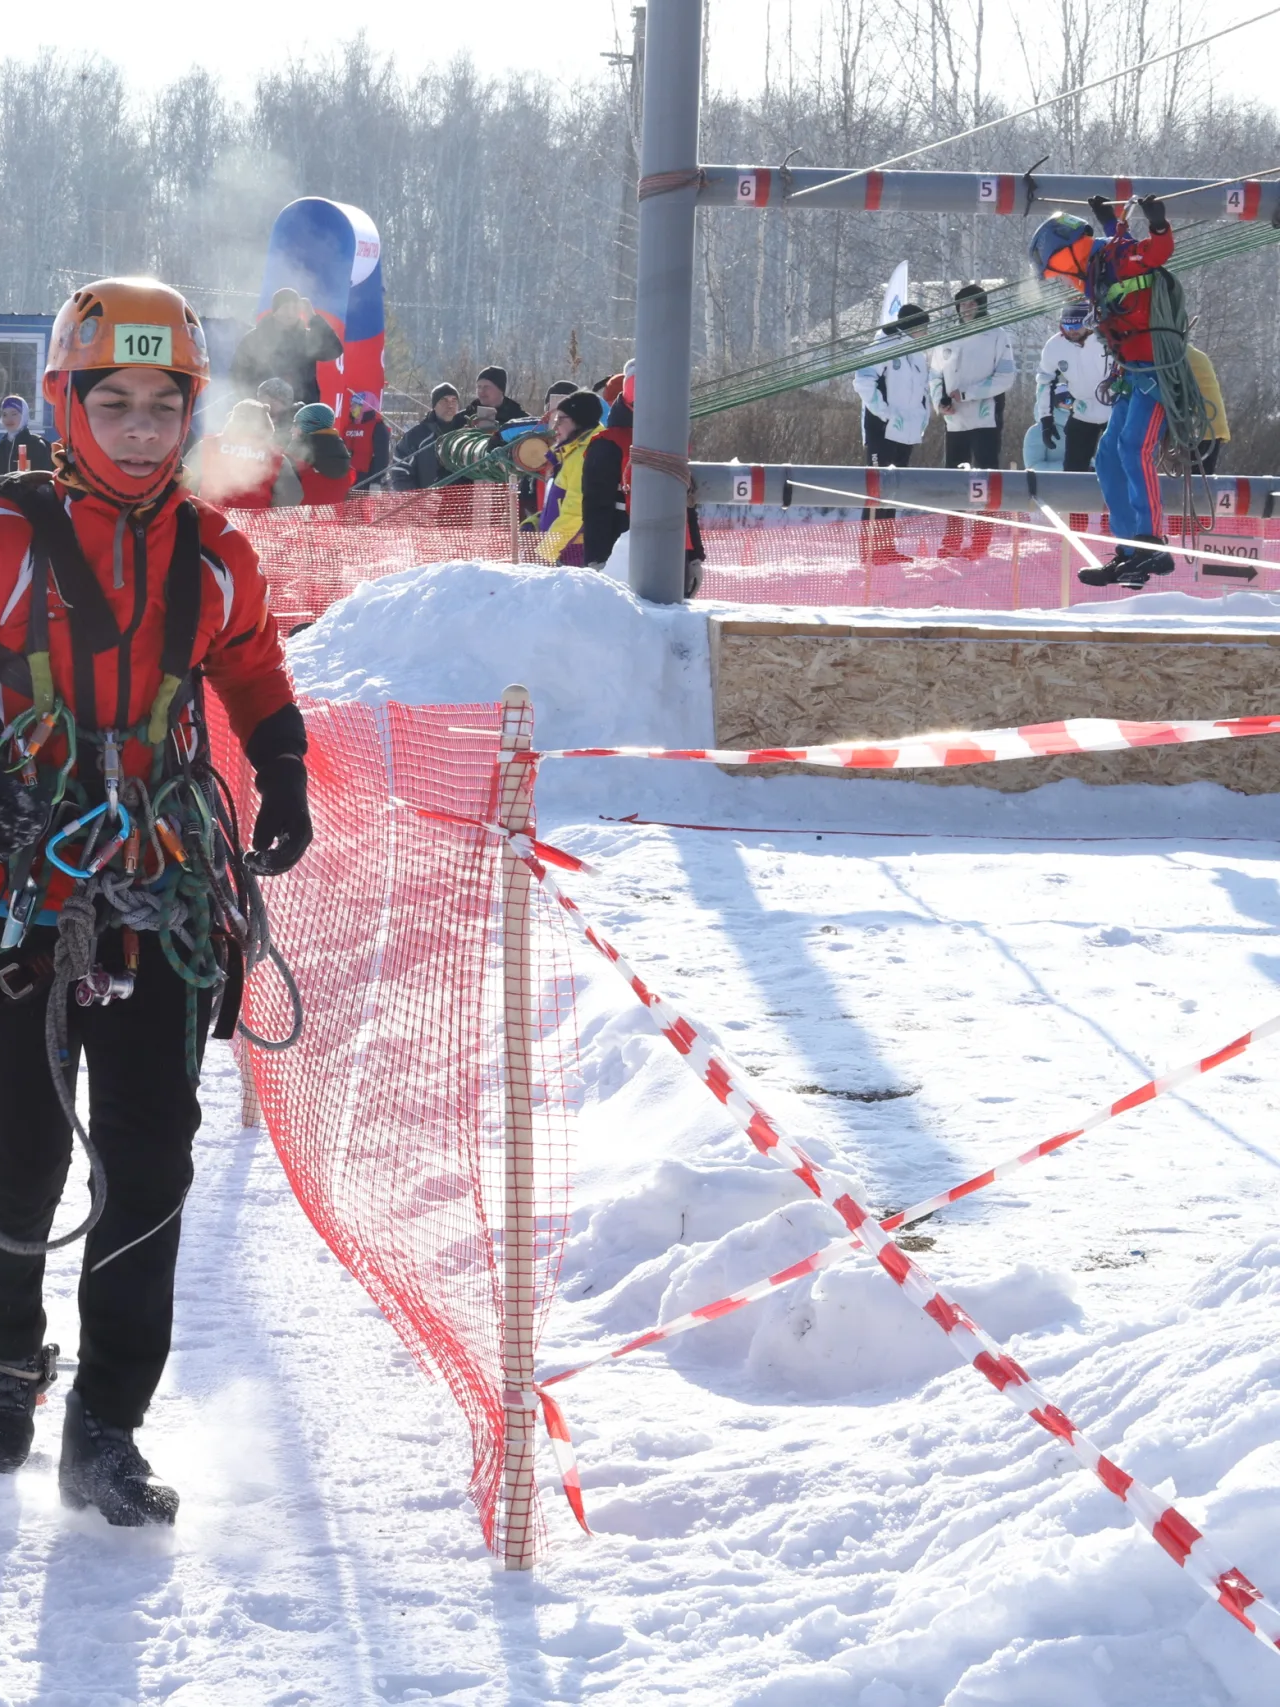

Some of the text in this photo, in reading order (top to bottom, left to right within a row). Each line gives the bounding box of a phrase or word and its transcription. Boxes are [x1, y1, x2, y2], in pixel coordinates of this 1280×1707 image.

[740, 180, 751, 197] 6
[981, 181, 992, 197] 5
[1228, 191, 1240, 207] 4
[124, 334, 163, 357] 107
[736, 481, 748, 497] 6
[972, 482, 983, 498] 5
[1219, 493, 1231, 509] 4
[1204, 544, 1259, 560] ВЫХОД
